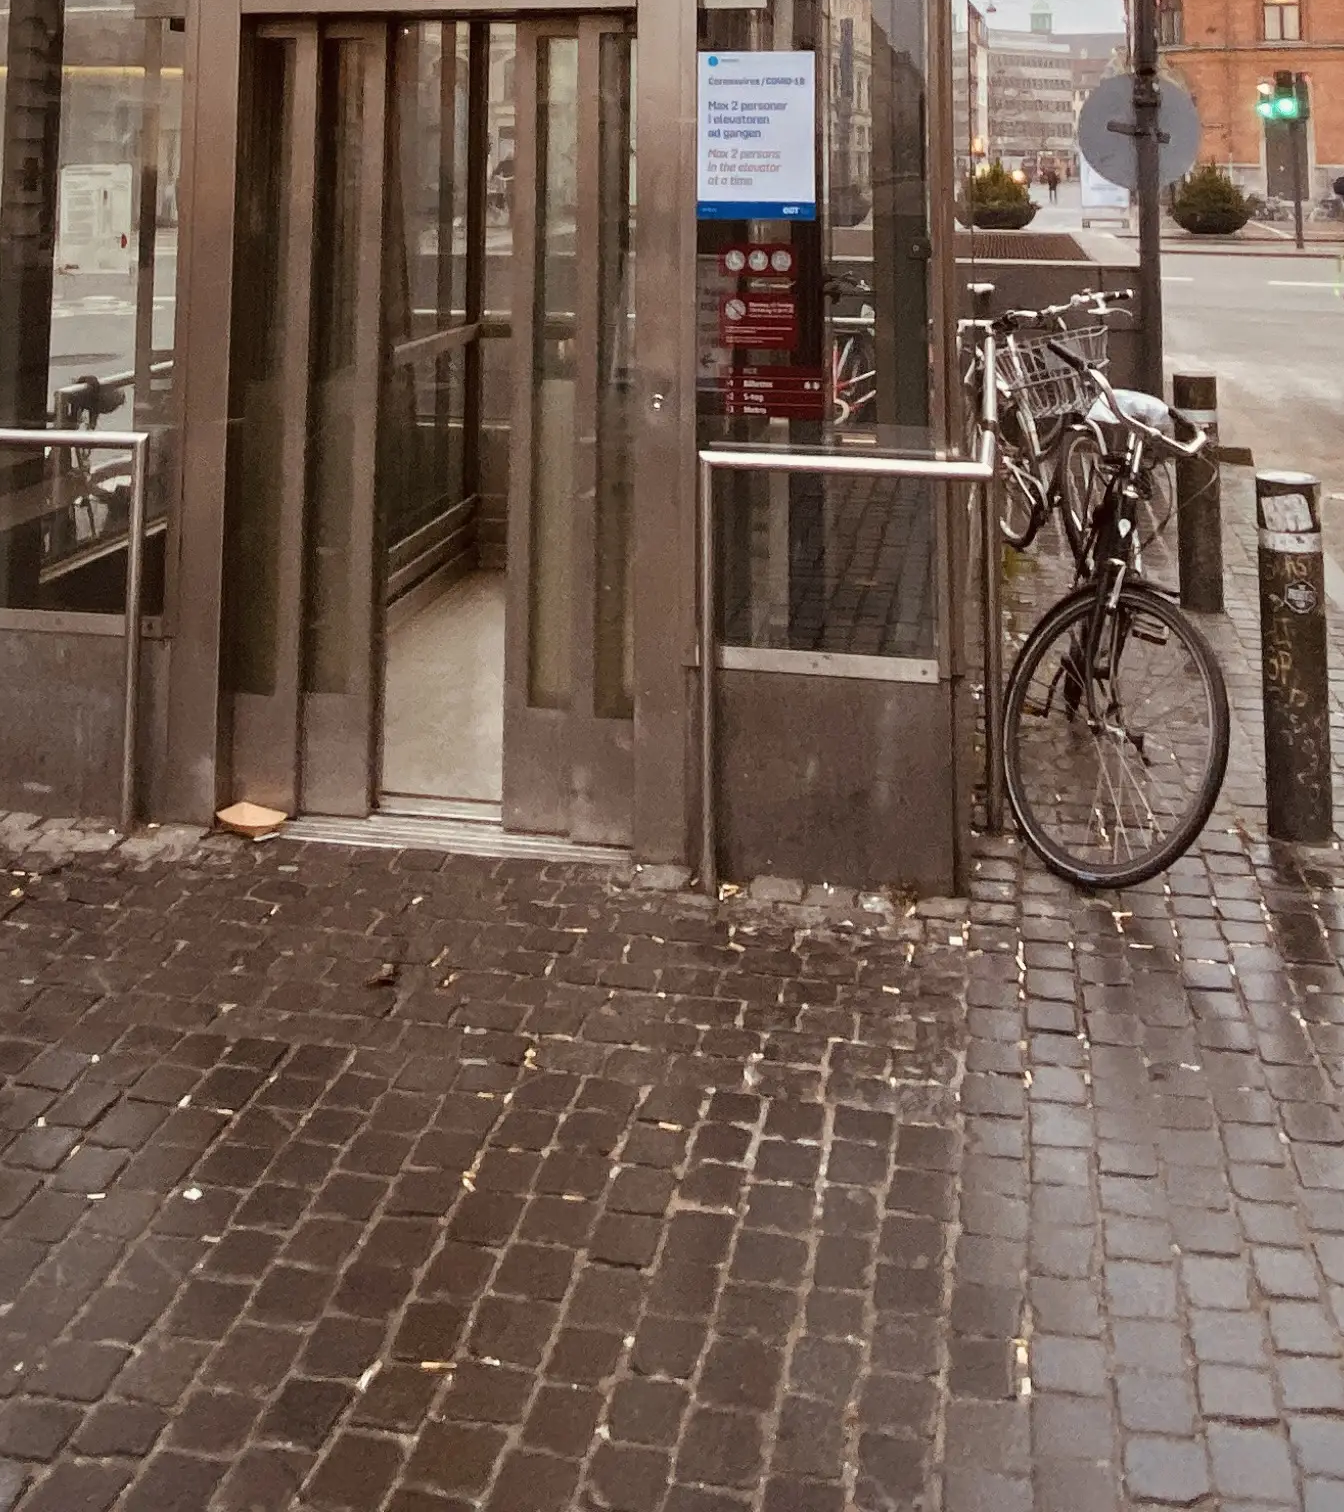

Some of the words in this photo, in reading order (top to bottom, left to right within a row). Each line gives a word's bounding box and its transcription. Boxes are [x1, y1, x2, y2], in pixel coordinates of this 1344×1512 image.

[708, 101, 729, 110] Max
[731, 100, 738, 110] 2
[741, 101, 788, 112] personer
[713, 113, 770, 125] elevatoren
[723, 129, 762, 141] gangen
[708, 149, 728, 159] Max
[731, 149, 738, 159] 2
[739, 150, 781, 161] persons
[720, 162, 736, 172] the
[738, 162, 782, 173] elevator
[708, 176, 718, 186] at
[730, 176, 753, 186] time
